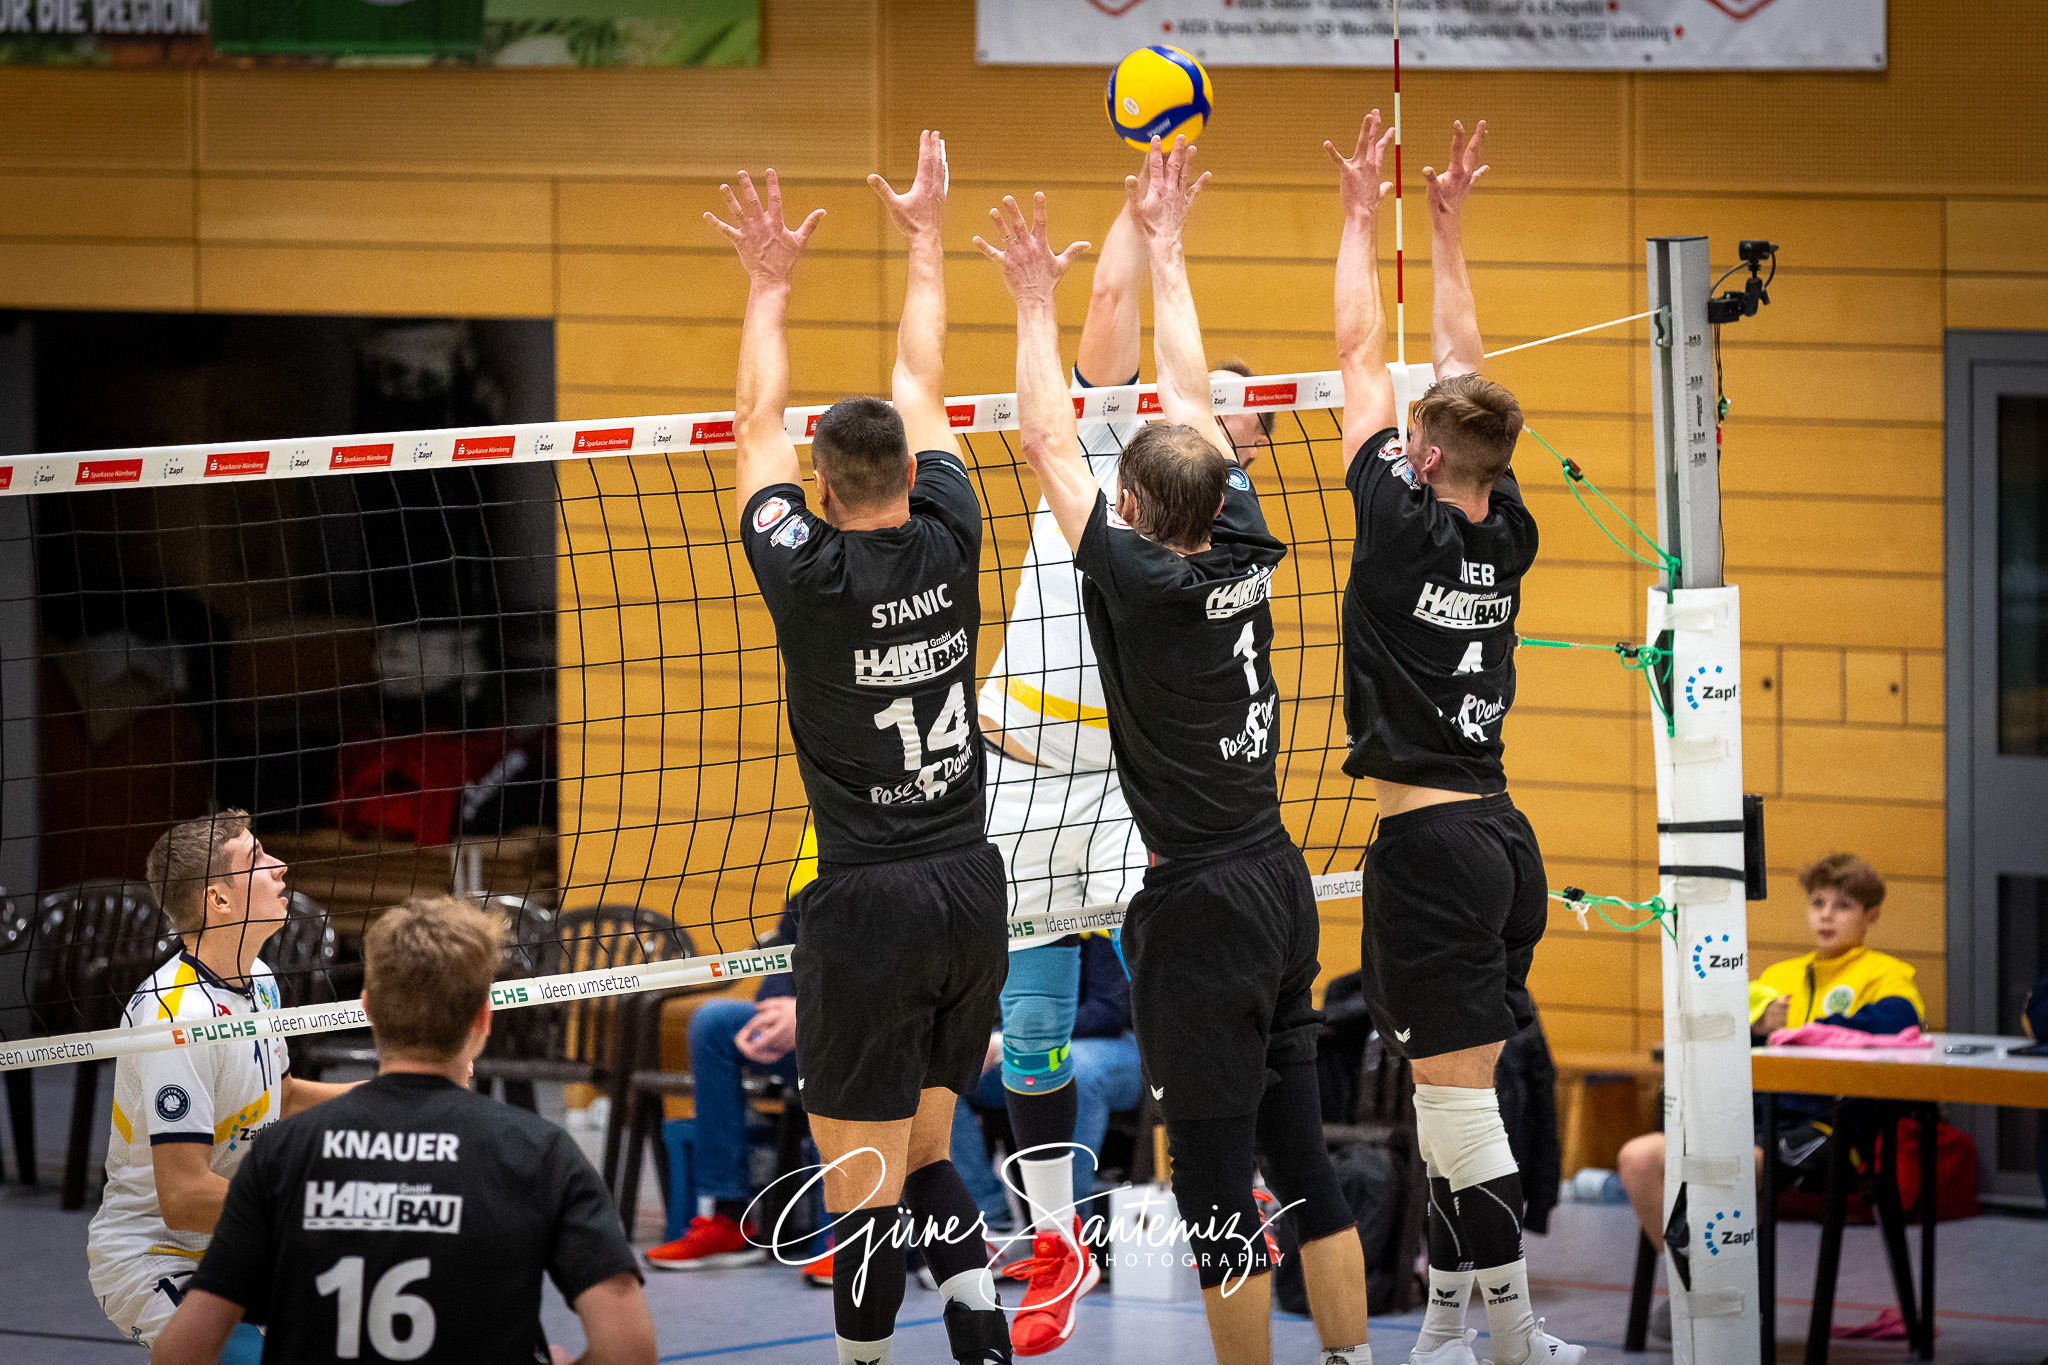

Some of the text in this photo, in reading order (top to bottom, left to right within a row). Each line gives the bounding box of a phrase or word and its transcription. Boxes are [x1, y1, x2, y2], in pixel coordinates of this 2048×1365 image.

[36, 0, 88, 33] DIE
[1213, 397, 1227, 405] Zapf
[1319, 390, 1331, 398] Zapf
[998, 412, 1011, 420] Zapf
[1107, 404, 1120, 412] Zapf
[539, 443, 554, 452] Zapf
[586, 439, 608, 447] Sparkasse
[608, 437, 629, 446] Nürnberg
[658, 434, 672, 443] Zapf
[343, 455, 366, 464] Sparkasse
[366, 453, 388, 463] Nürnberg
[418, 450, 433, 459] Zapf
[466, 447, 488, 455] Sparkasse
[488, 445, 510, 454] Nürnberg
[169, 466, 184, 476] Zapf
[218, 463, 242, 472] Sparkasse
[242, 461, 264, 471] Nürnberg
[295, 458, 310, 467] Zapf
[39, 474, 55, 483] Zapf
[90, 470, 115, 479] Sparkasse
[115, 468, 137, 478] Nürnberg
[1459, 557, 1495, 587] IEB
[1206, 573, 1259, 609] HART
[871, 582, 953, 629] STANIC
[1416, 582, 1481, 620] HART
[1474, 599, 1510, 626] BAU
[854, 630, 968, 677] HART GmbH BAU
[1702, 683, 1737, 702] Zapf
[873, 681, 970, 771] 14
[1315, 878, 1362, 897] umsetze
[1045, 915, 1078, 933] Ideen
[1080, 909, 1128, 929] umsetze
[728, 953, 788, 976] FUCHS
[1709, 952, 1744, 971] Zapf
[491, 973, 641, 1006] CHS Ideen umsetzen
[191, 1007, 367, 1043] FUCHS Ideen umsetze
[0, 1041, 95, 1066] een umsetzen
[321, 1129, 461, 1162] KNAUER
[303, 1180, 456, 1227] HART GmbH BAU
[1721, 1227, 1755, 1247] Zapf
[315, 1255, 437, 1362] 16
[1431, 1298, 1461, 1309] erima
[1488, 1292, 1519, 1306] erima
